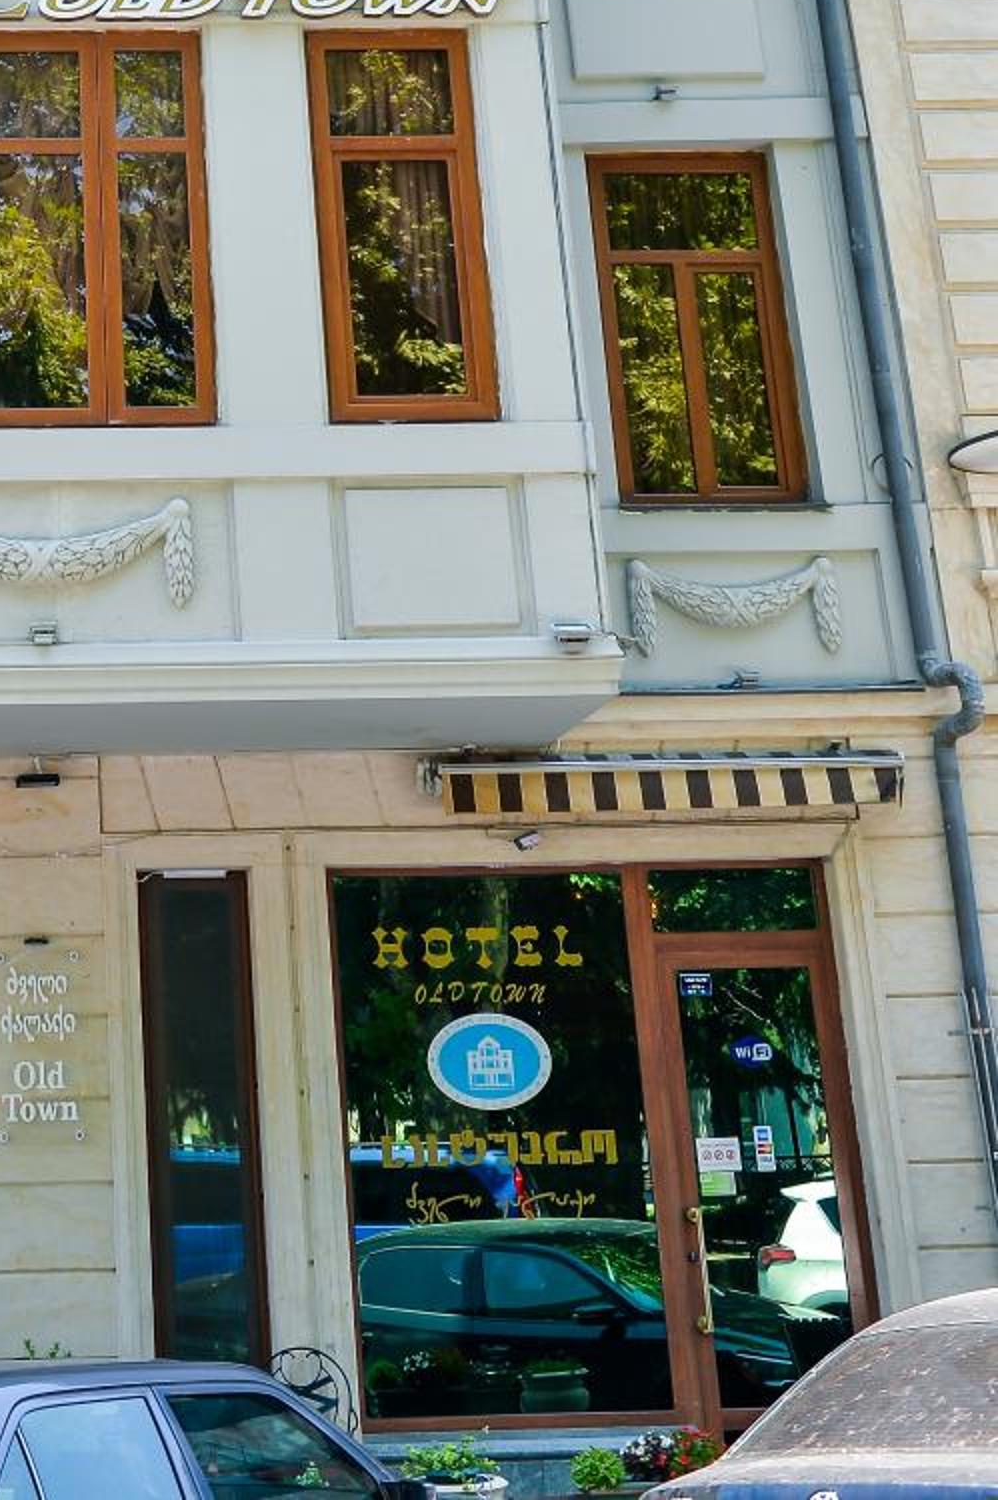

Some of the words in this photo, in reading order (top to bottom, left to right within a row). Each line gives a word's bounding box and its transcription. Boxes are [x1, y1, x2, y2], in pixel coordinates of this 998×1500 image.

[371, 924, 583, 970] HOTEL
[6, 966, 67, 1003] ძველი
[1, 1004, 75, 1042] ქალაქი
[13, 1061, 67, 1090] Old
[1, 1094, 79, 1123] Town
[380, 1126, 619, 1169] სასტუმრო
